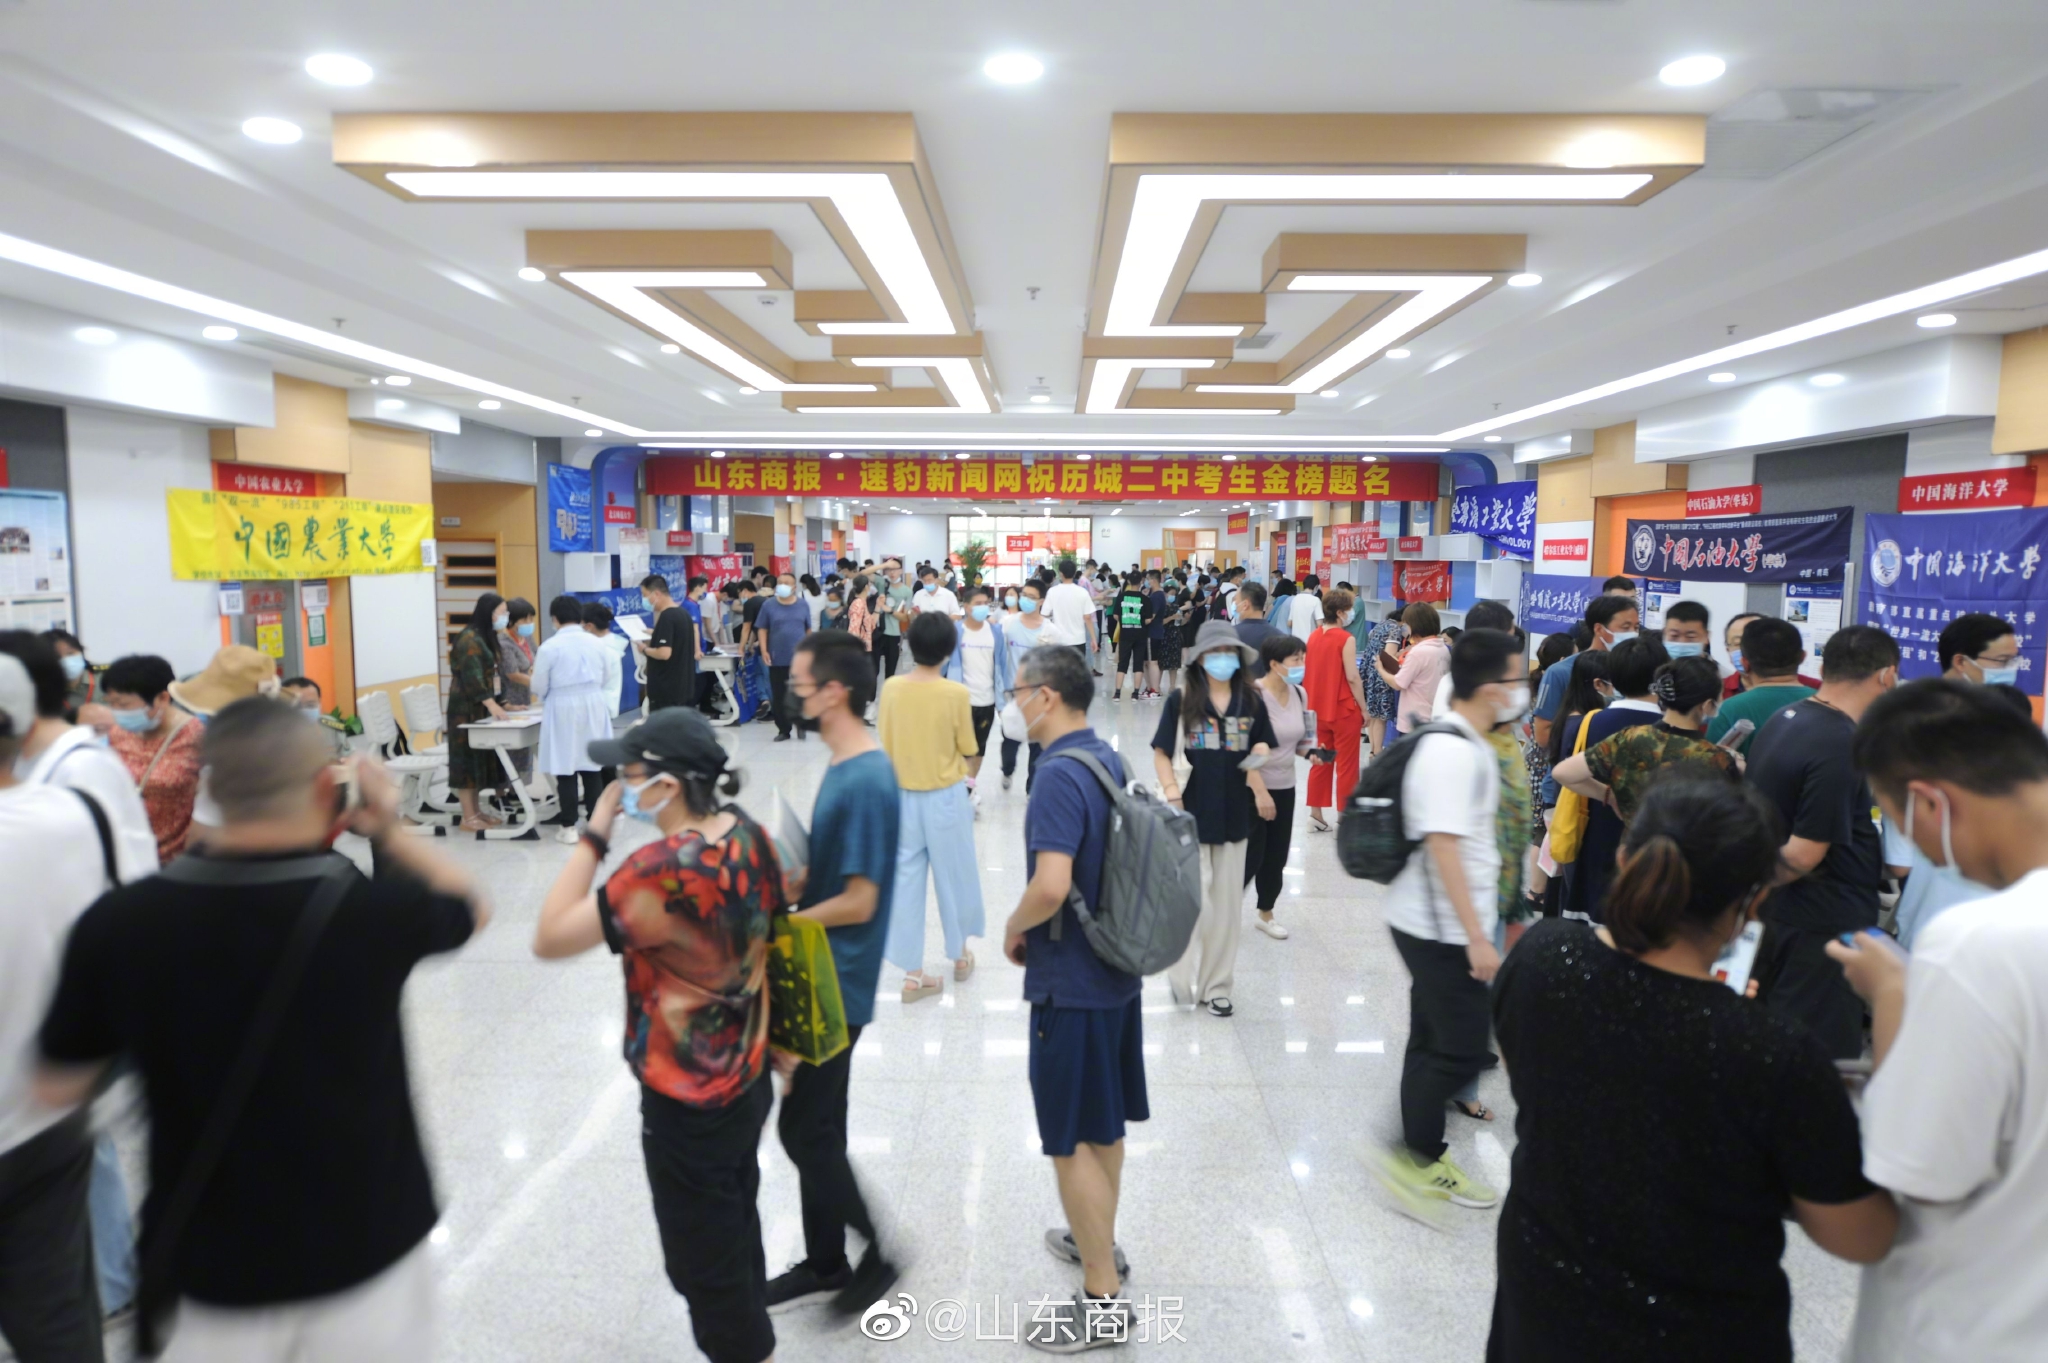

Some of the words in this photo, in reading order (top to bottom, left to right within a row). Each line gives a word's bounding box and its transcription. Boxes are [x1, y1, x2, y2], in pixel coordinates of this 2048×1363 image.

[235, 473, 304, 494] 中国农业大学
[694, 460, 1390, 495] 山东商报·速豹新闻网祝历城二中考生金榜题名
[1912, 478, 2009, 502] 中国海洋大学
